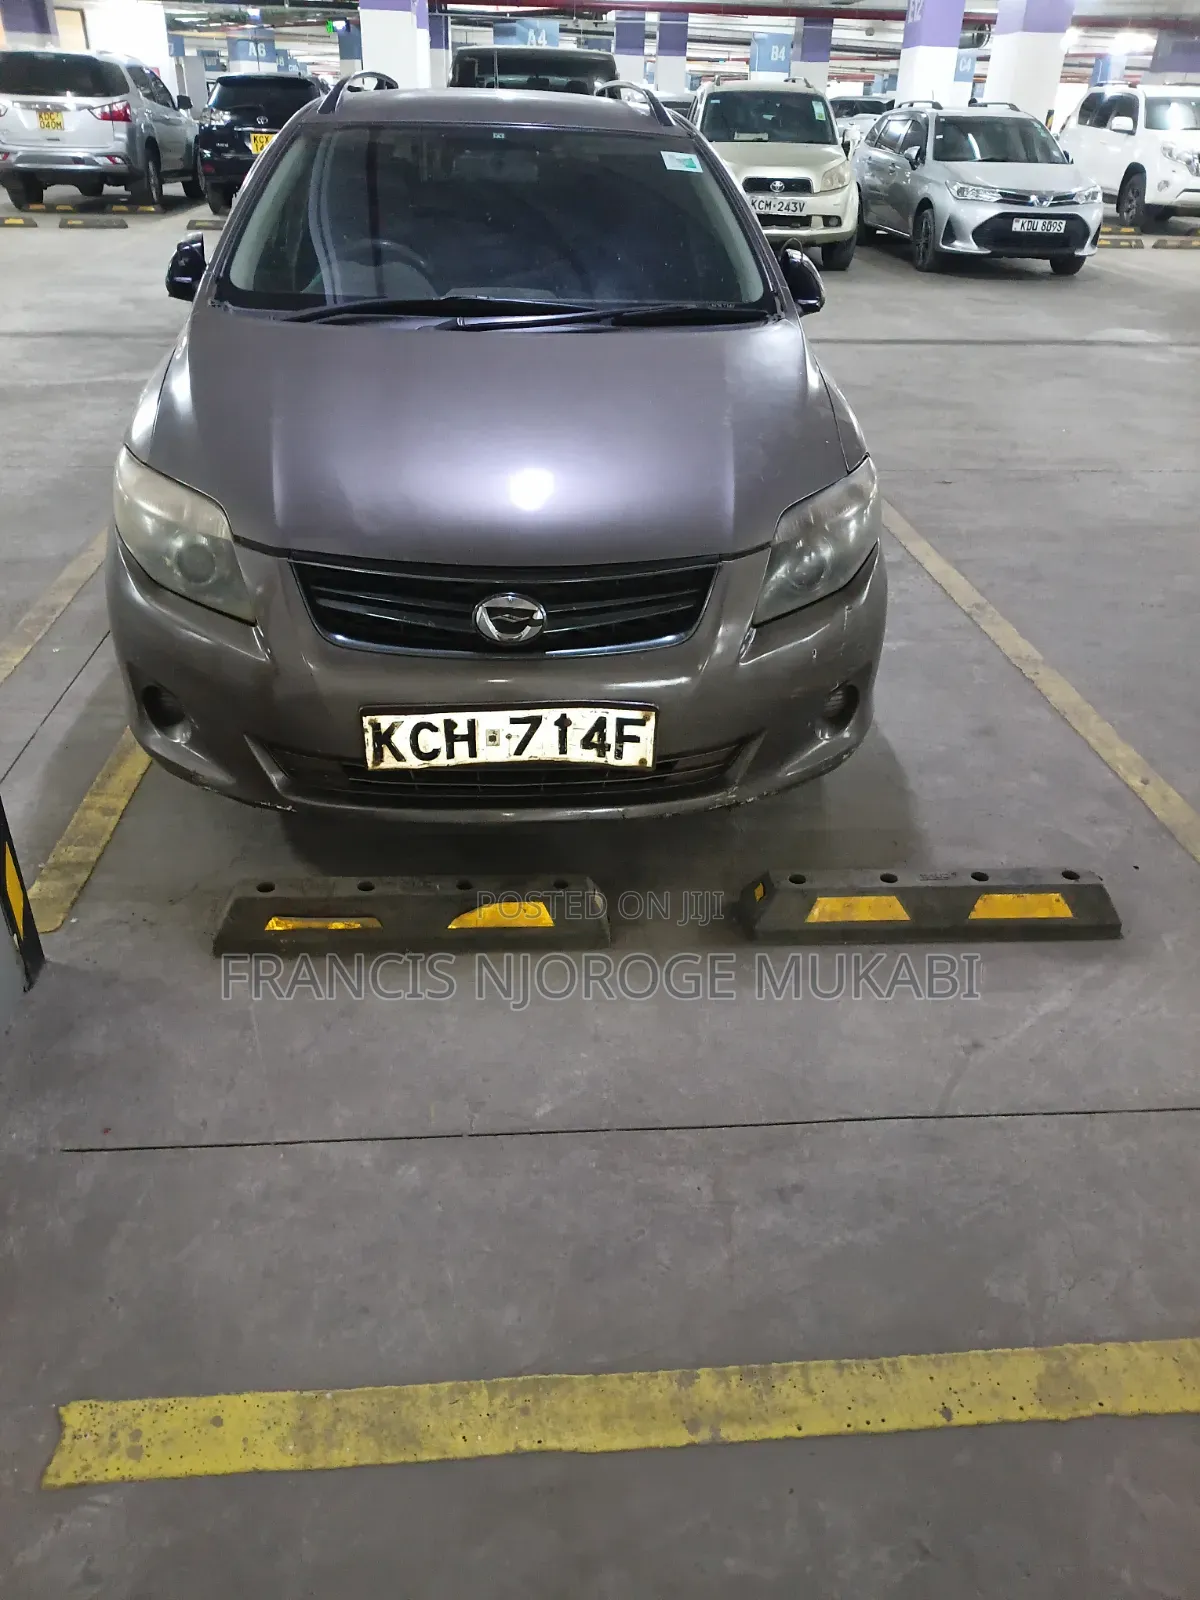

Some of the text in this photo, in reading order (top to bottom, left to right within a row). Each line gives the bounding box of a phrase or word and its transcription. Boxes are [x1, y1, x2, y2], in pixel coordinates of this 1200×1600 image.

[527, 28, 547, 46] A4
[248, 41, 266, 57] A6
[770, 45, 786, 61] B4
[253, 135, 269, 144] KCX
[751, 199, 805, 213] KCM 243V
[1020, 220, 1039, 231] KDU
[371, 713, 647, 765] KCH 714F
